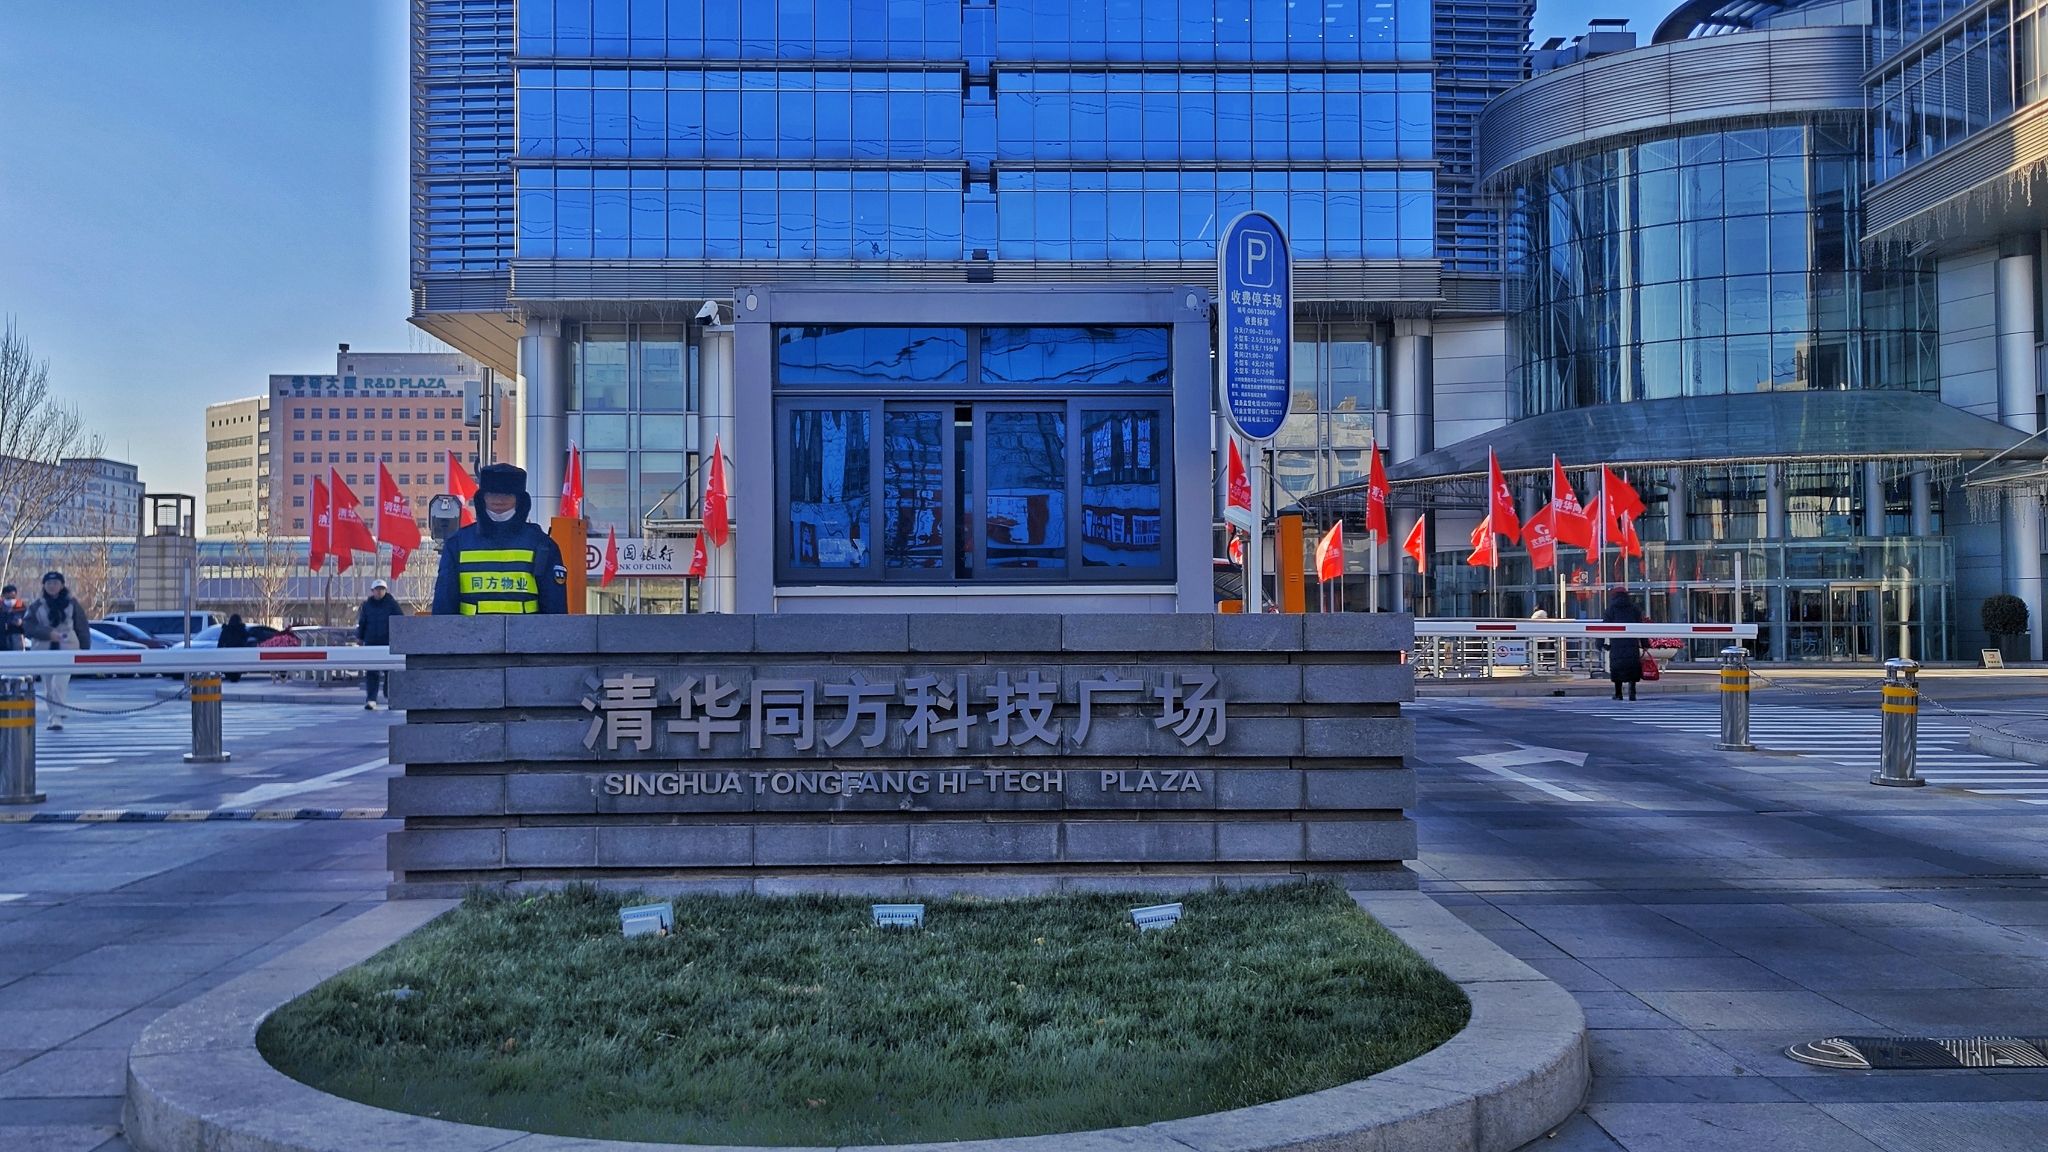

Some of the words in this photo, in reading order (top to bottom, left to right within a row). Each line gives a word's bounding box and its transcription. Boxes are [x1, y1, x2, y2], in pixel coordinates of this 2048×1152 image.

[1248, 238, 1267, 275] P
[1231, 289, 1283, 309] 收费停车场
[1244, 316, 1269, 327] 收费标准
[364, 377, 396, 389] R&D
[400, 377, 447, 389] PLAZA
[633, 563, 644, 571] OF
[646, 563, 672, 571] CHINA
[471, 576, 528, 590] 同方物业
[581, 672, 1226, 750] 清华同方科技广场
[604, 772, 743, 795] SINGHUA
[750, 771, 930, 796] TONGFANG
[938, 770, 1063, 794] HI-TECH
[1101, 770, 1202, 792] PLAZA
